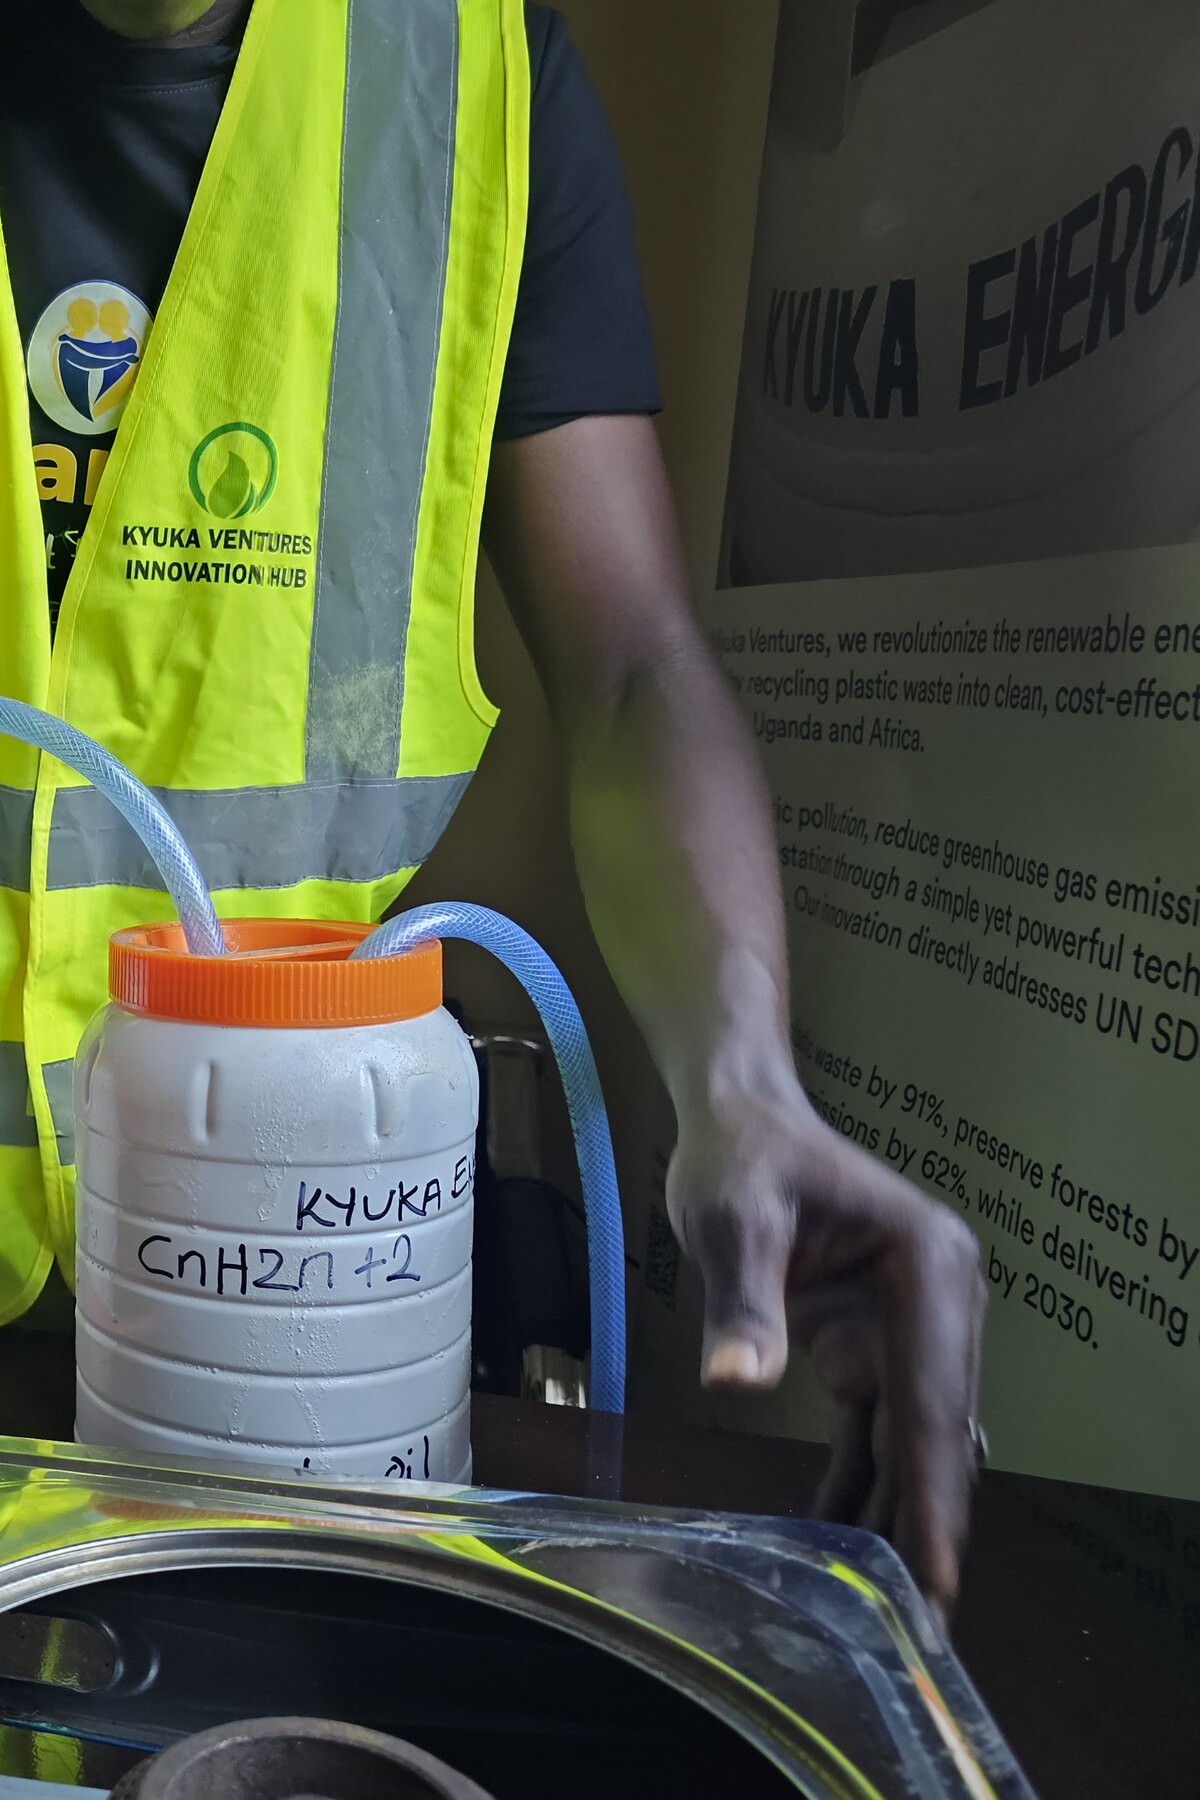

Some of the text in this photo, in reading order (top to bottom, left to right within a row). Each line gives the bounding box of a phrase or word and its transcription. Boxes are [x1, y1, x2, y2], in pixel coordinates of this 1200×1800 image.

[763, 278, 919, 419] KYUKA
[122, 526, 200, 549] KYUKA
[209, 528, 312, 556] VENTURES
[125, 559, 307, 589] INNOVATION HUB
[749, 627, 831, 657] Ventures,
[838, 632, 867, 653] we
[873, 619, 987, 653] revolutionize
[993, 617, 1021, 653] the
[1025, 612, 1145, 653] renewable
[748, 668, 829, 704] recycling
[835, 669, 898, 704] plastic
[903, 676, 952, 705] waste
[956, 672, 990, 707] into
[995, 673, 1048, 718] clean,
[1055, 677, 1200, 721] cost-effect
[753, 711, 924, 752] Uganda and Africa.
[799, 802, 869, 845] pollution,
[875, 818, 939, 857] reduce
[943, 837, 1049, 888] greenhouse
[1054, 867, 1098, 903] gas
[794, 885, 820, 917] Our
[821, 893, 902, 949] innovation
[907, 925, 980, 986] directly
[983, 956, 1087, 1024] addresses
[1096, 992, 1143, 1045] UN
[833, 852, 900, 900] through
[905, 879, 917, 902] a
[921, 877, 980, 924] simple
[984, 902, 1012, 936] yet
[1016, 926, 1124, 972] powerful
[1133, 943, 1200, 997] tech
[297, 1178, 441, 1231] KYUKA
[815, 1045, 1200, 1280] waste by 91%, preserve forests by
[885, 1128, 917, 1174] by
[922, 1150, 970, 1210] 62%,
[978, 1189, 1035, 1245] while
[1042, 1225, 1188, 1347] delivering
[988, 1245, 1098, 1350] by 2030.
